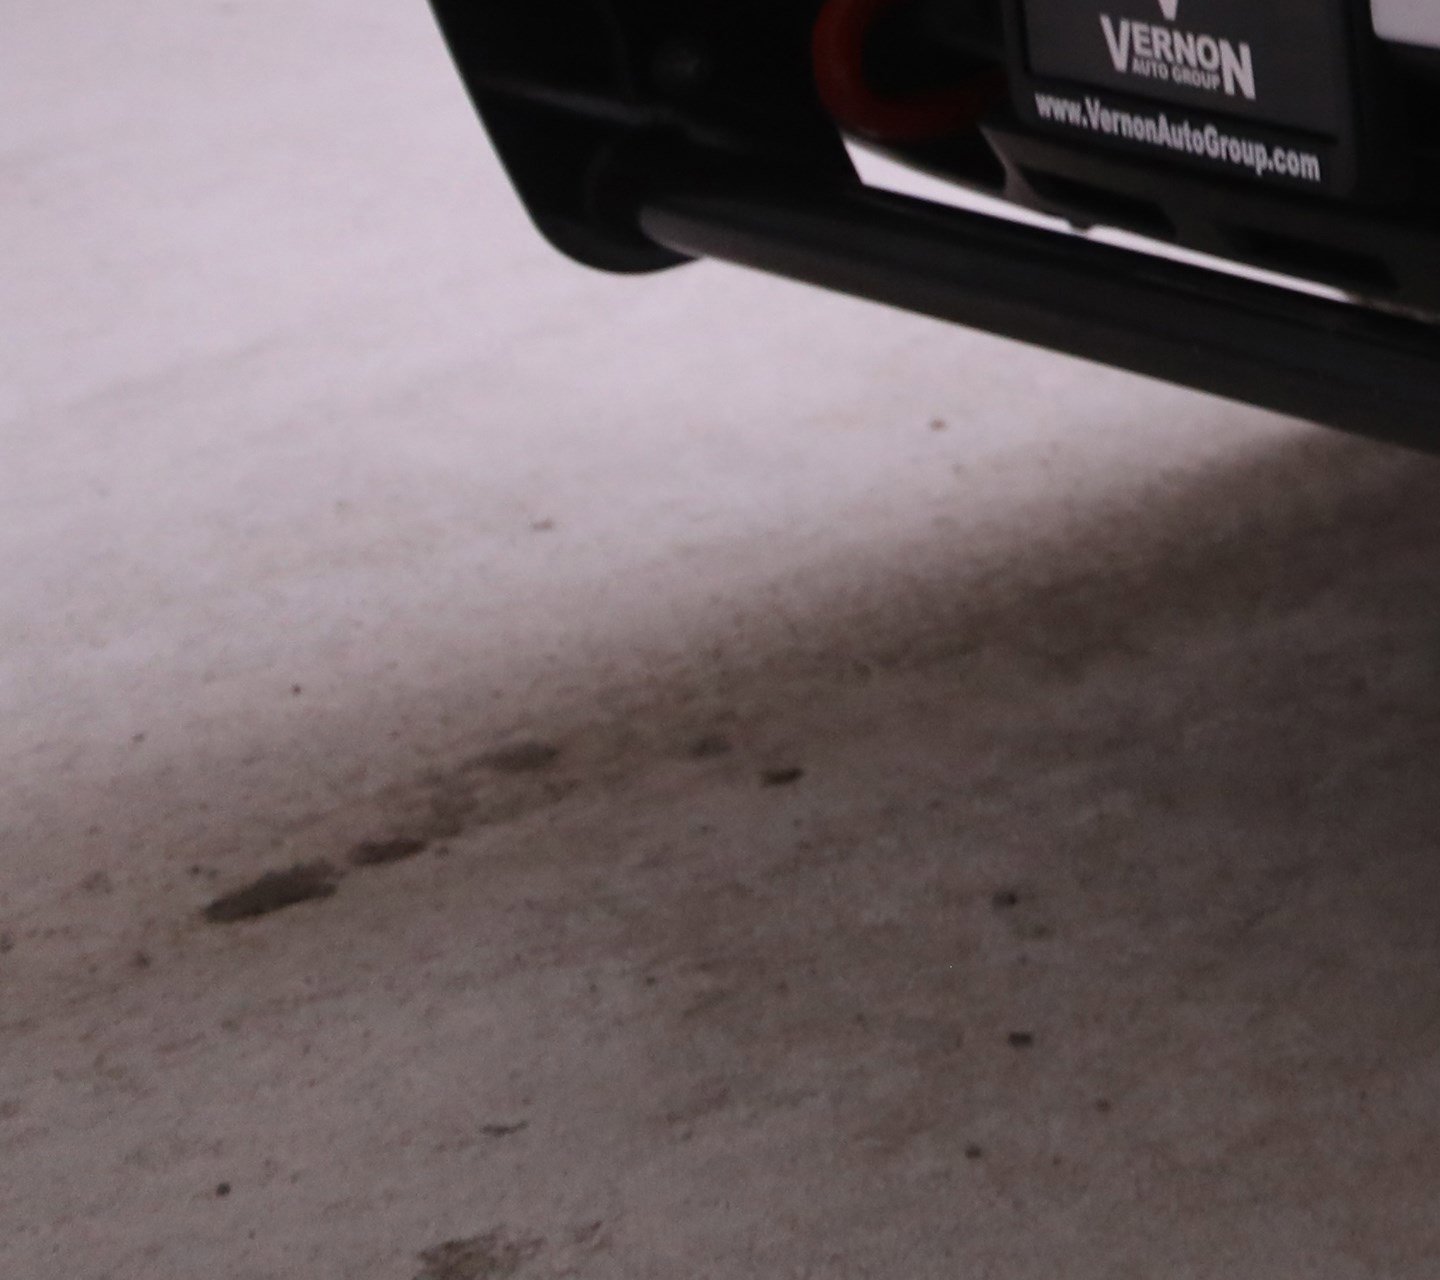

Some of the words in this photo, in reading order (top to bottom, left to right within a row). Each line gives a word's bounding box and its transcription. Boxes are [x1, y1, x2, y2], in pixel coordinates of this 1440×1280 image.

[1100, 14, 1257, 100] VERNON
[1132, 58, 1168, 80] AUTO
[1173, 66, 1221, 91] GROUP
[1035, 92, 1321, 182] www.VernonAutoGroup.com
